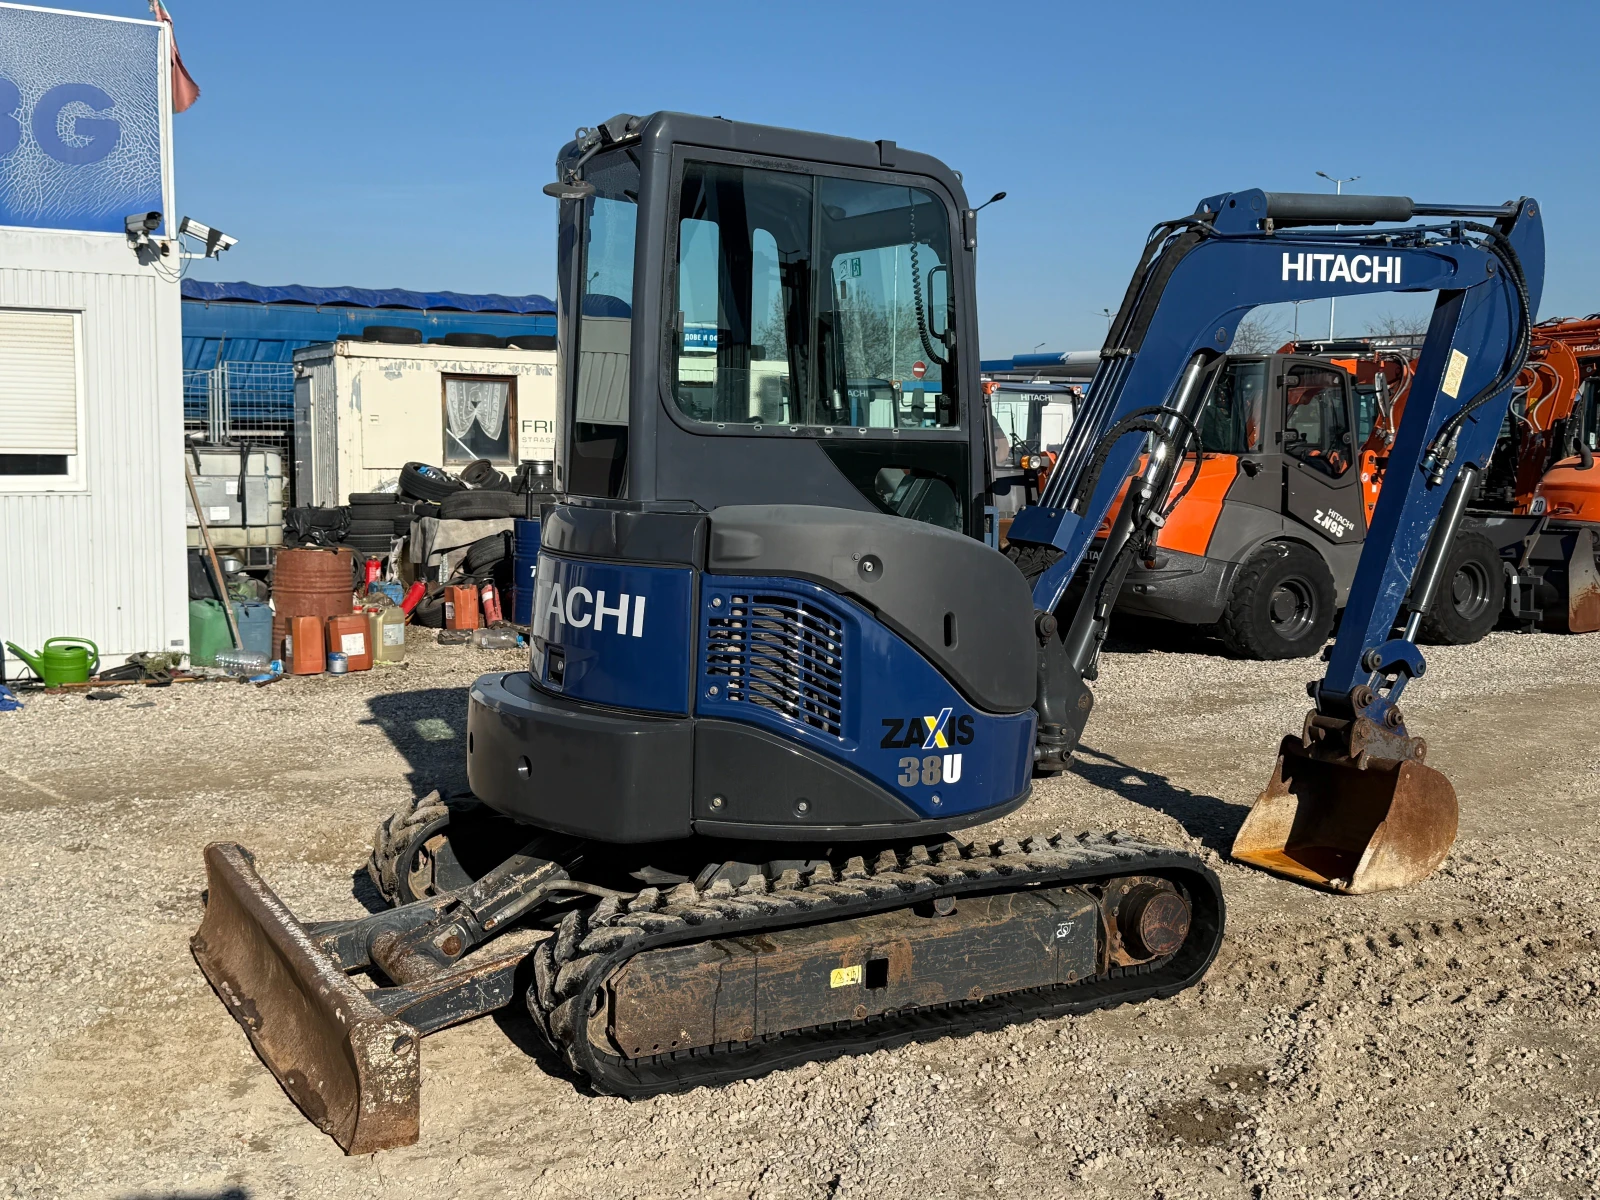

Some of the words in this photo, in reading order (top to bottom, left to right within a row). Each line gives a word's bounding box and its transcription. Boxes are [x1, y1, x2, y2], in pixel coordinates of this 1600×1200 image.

[1282, 252, 1401, 284] HITACHI
[1020, 394, 1053, 402] HITACHI
[522, 420, 556, 433] FRI
[1532, 500, 1544, 513] 20
[1328, 508, 1355, 531] HITACHI
[880, 707, 975, 750] ZAXIS
[897, 753, 963, 787] 38U
